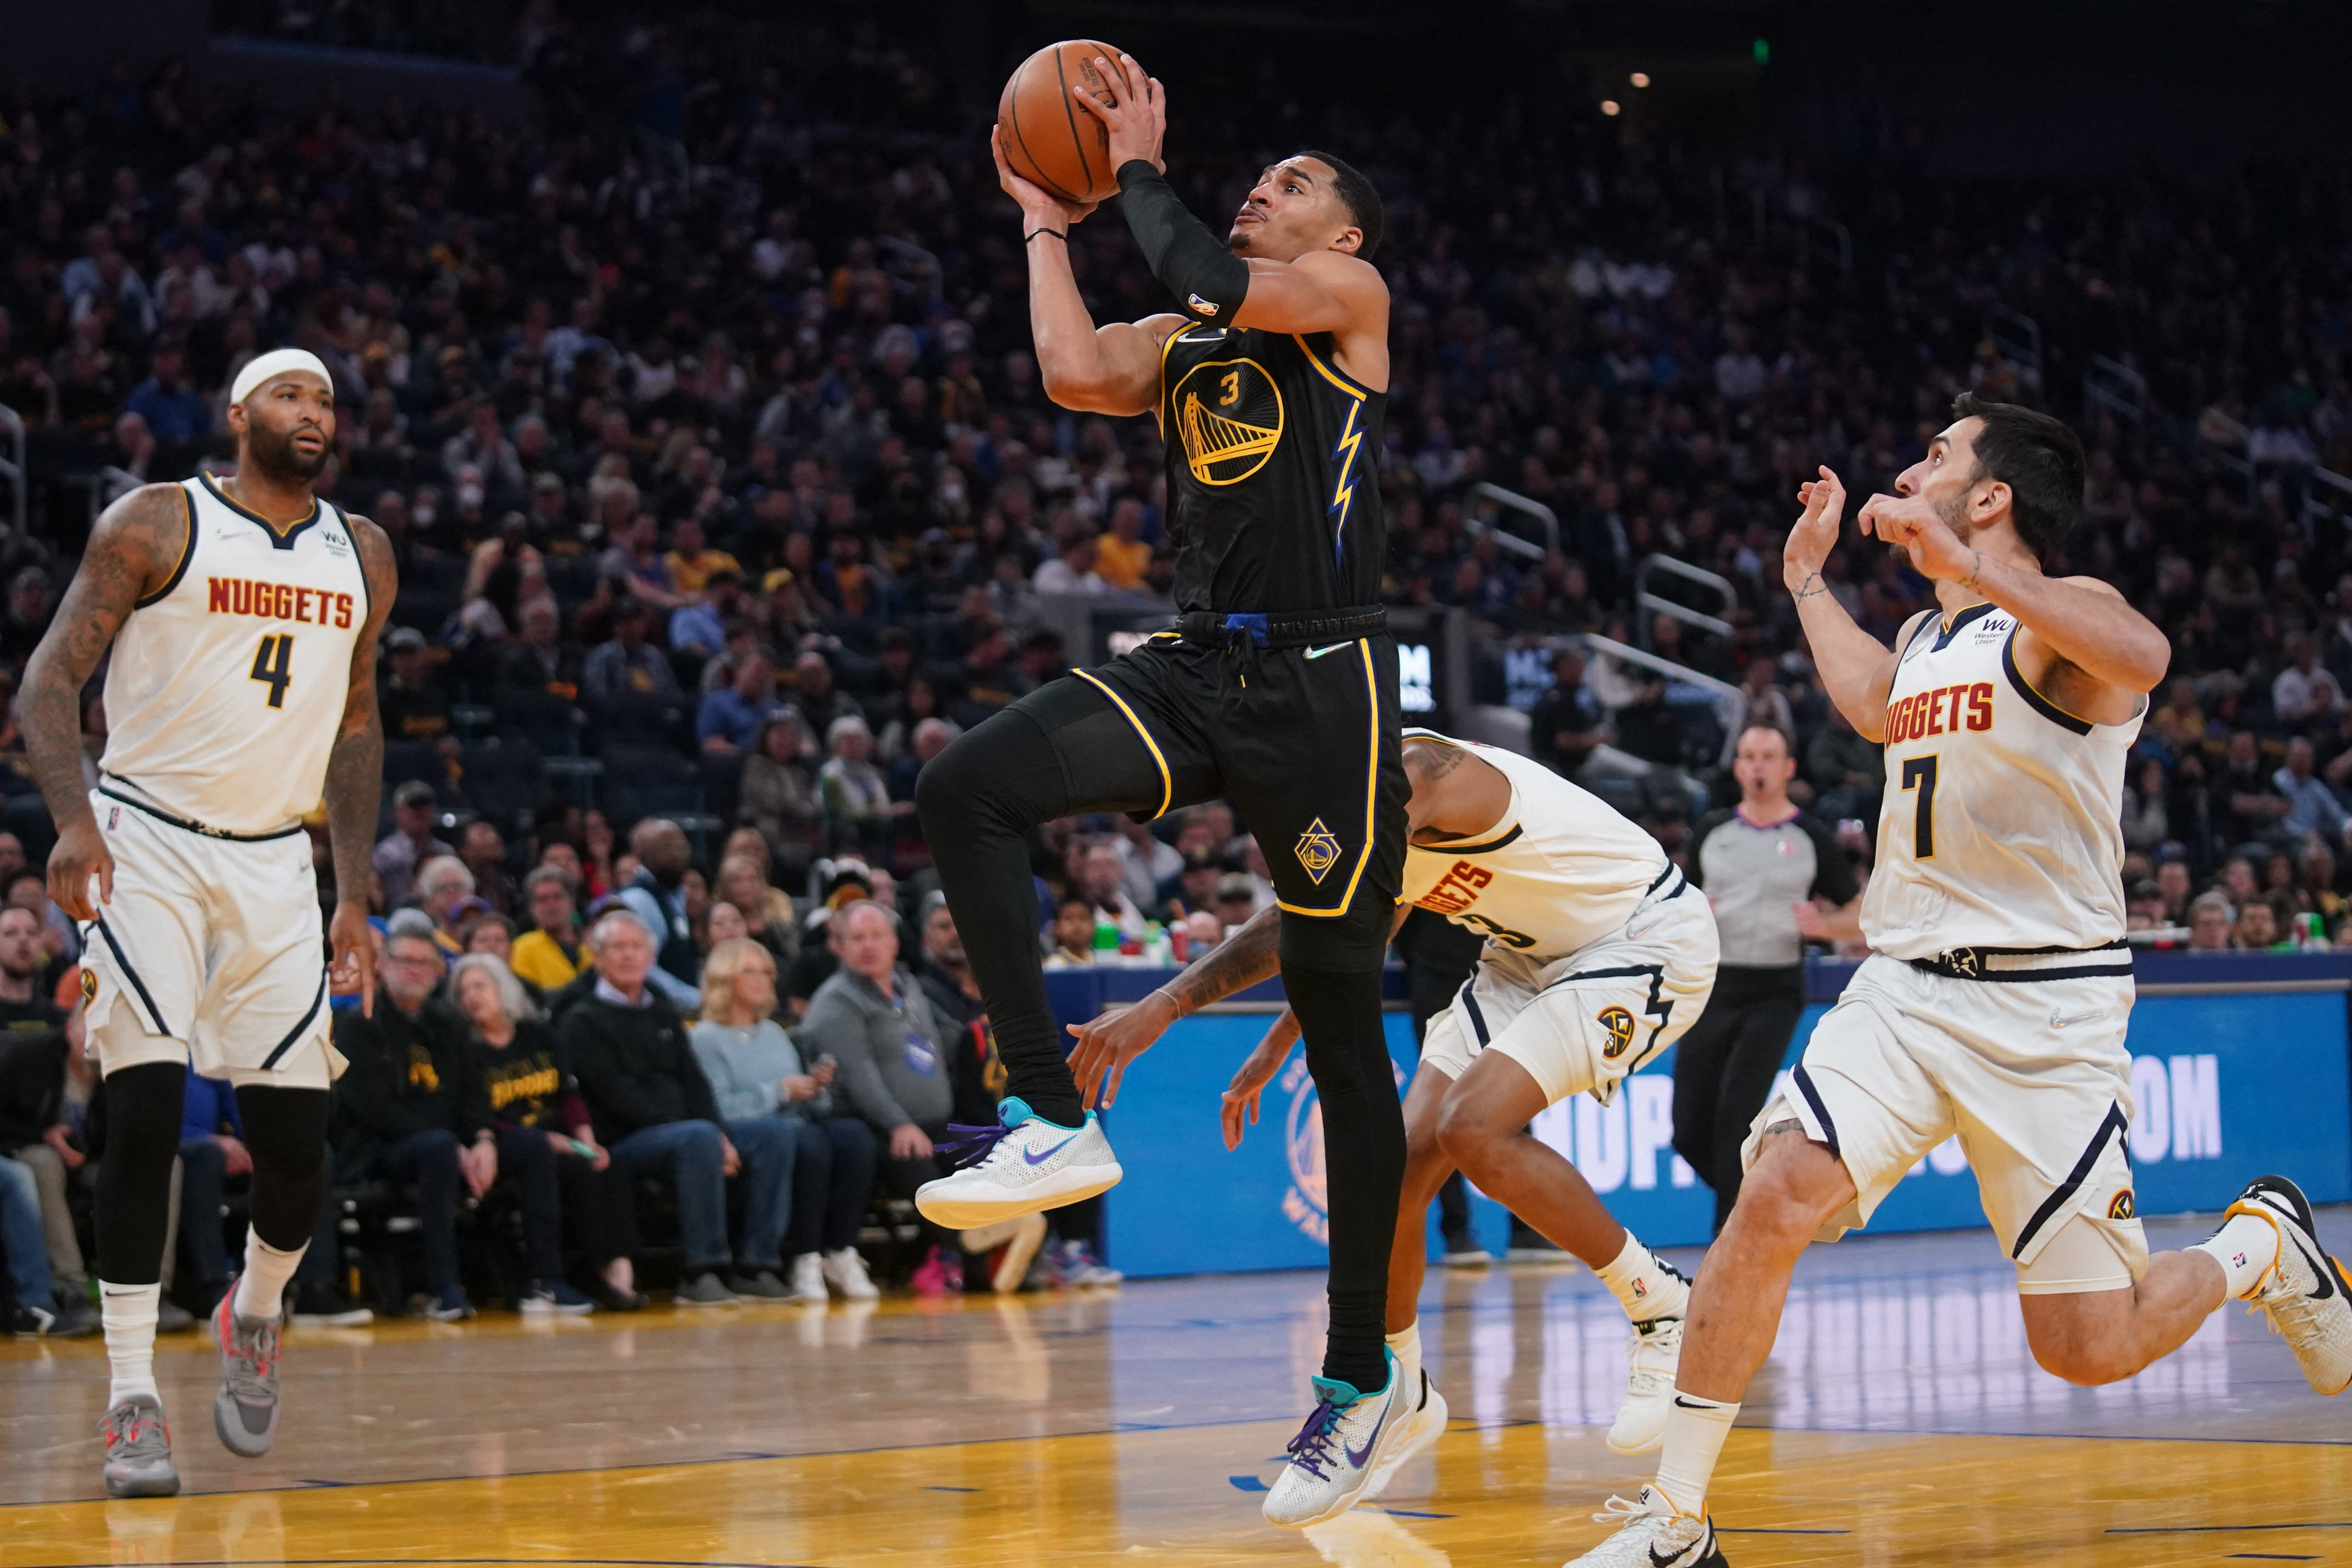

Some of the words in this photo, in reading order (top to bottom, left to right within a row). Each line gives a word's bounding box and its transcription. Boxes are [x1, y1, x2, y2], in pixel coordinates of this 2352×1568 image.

[1220, 370, 1239, 406] 3
[321, 530, 346, 546] WU
[208, 576, 353, 630] NUGGETS
[1982, 619, 2016, 631] WU
[249, 633, 294, 710] 4
[1900, 753, 1939, 862] 7
